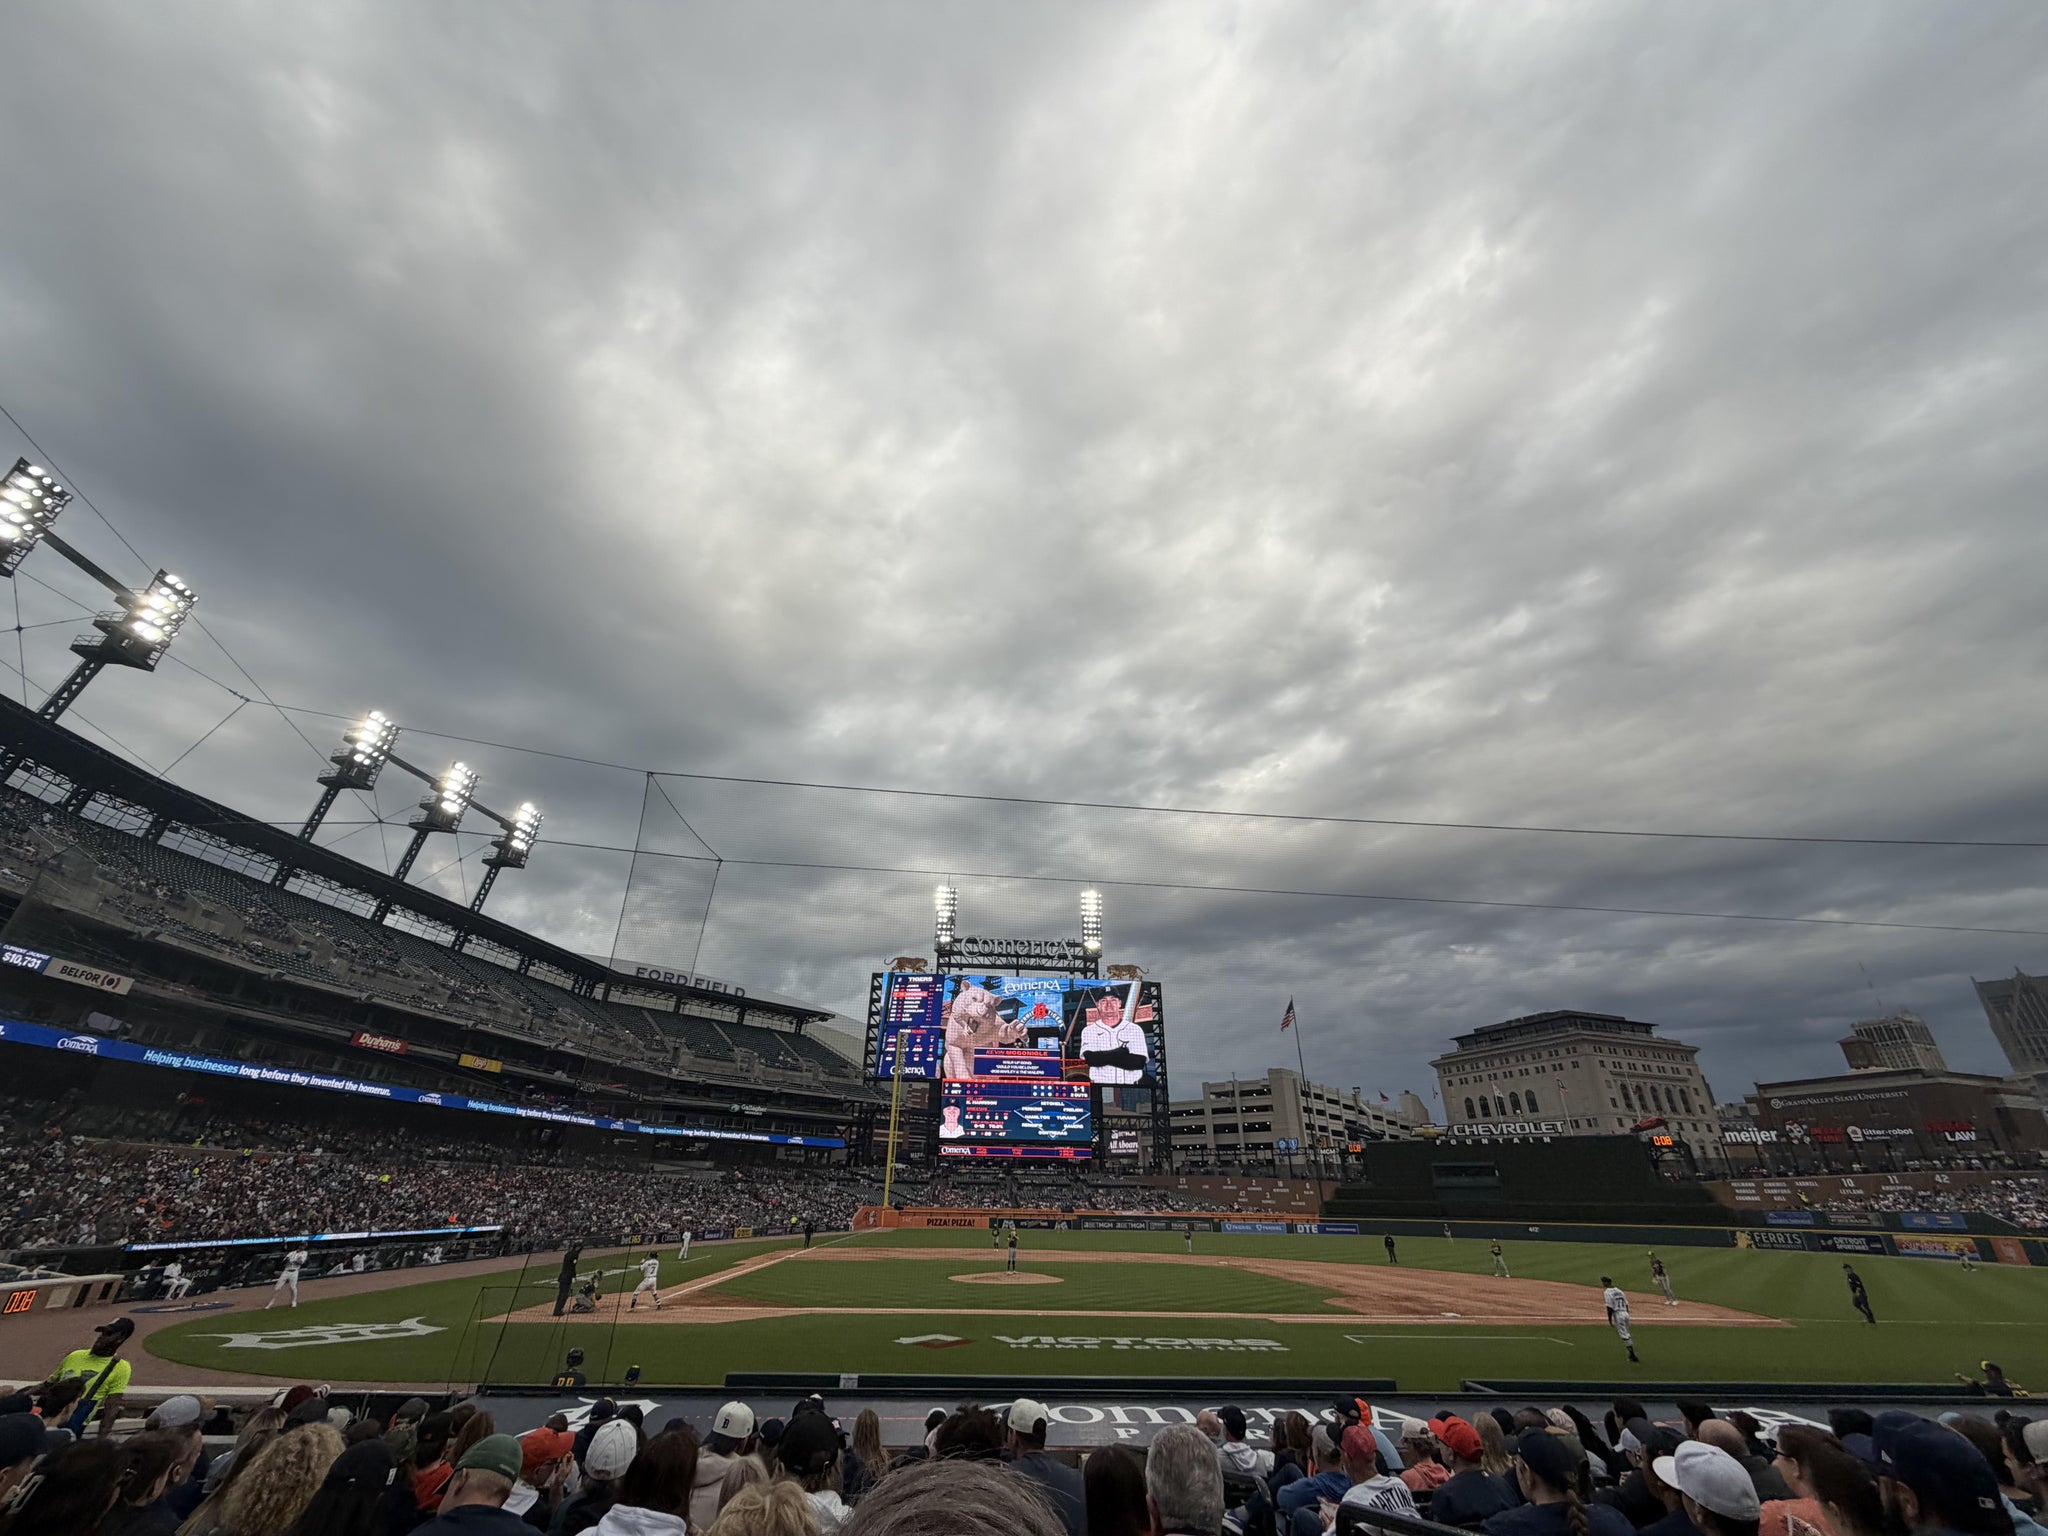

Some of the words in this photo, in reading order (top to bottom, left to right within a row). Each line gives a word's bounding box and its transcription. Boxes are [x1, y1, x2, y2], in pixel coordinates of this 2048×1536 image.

[2, 951, 42, 969] $10,731
[992, 956, 1045, 966] PARK
[59, 965, 101, 983] BELFOR
[636, 966, 688, 986] FORD
[694, 977, 746, 997] FIELD
[358, 1033, 402, 1050] Dunham's
[143, 1049, 183, 1068] Helping
[183, 1058, 239, 1074] businesses
[239, 1065, 259, 1079] long
[260, 1068, 290, 1082] before
[290, 1072, 309, 1085] they
[310, 1075, 344, 1089] invented
[344, 1078, 358, 1091] the
[358, 1082, 391, 1096] homerun.
[467, 1099, 488, 1112] Helping
[489, 1102, 516, 1114] businesses
[741, 1103, 768, 1113] Gallagher
[1453, 1120, 1565, 1136] CHEVROLET
[1435, 1136, 1551, 1146] FOUNTAIN
[1724, 1127, 1778, 1145] meijer
[1944, 1131, 1976, 1142] LAW
[1841, 1178, 1855, 1187] 10
[1887, 1175, 1899, 1184] 11
[1934, 1174, 1950, 1184] 42
[927, 1218, 950, 1227] PIZZA!
[951, 1219, 975, 1227] PIZZA!
[1297, 1224, 1319, 1234] DTE
[1753, 1232, 1802, 1245] FERRIS
[1833, 1236, 1866, 1244] DETROIT
[992, 1335, 1282, 1346] VICTORS
